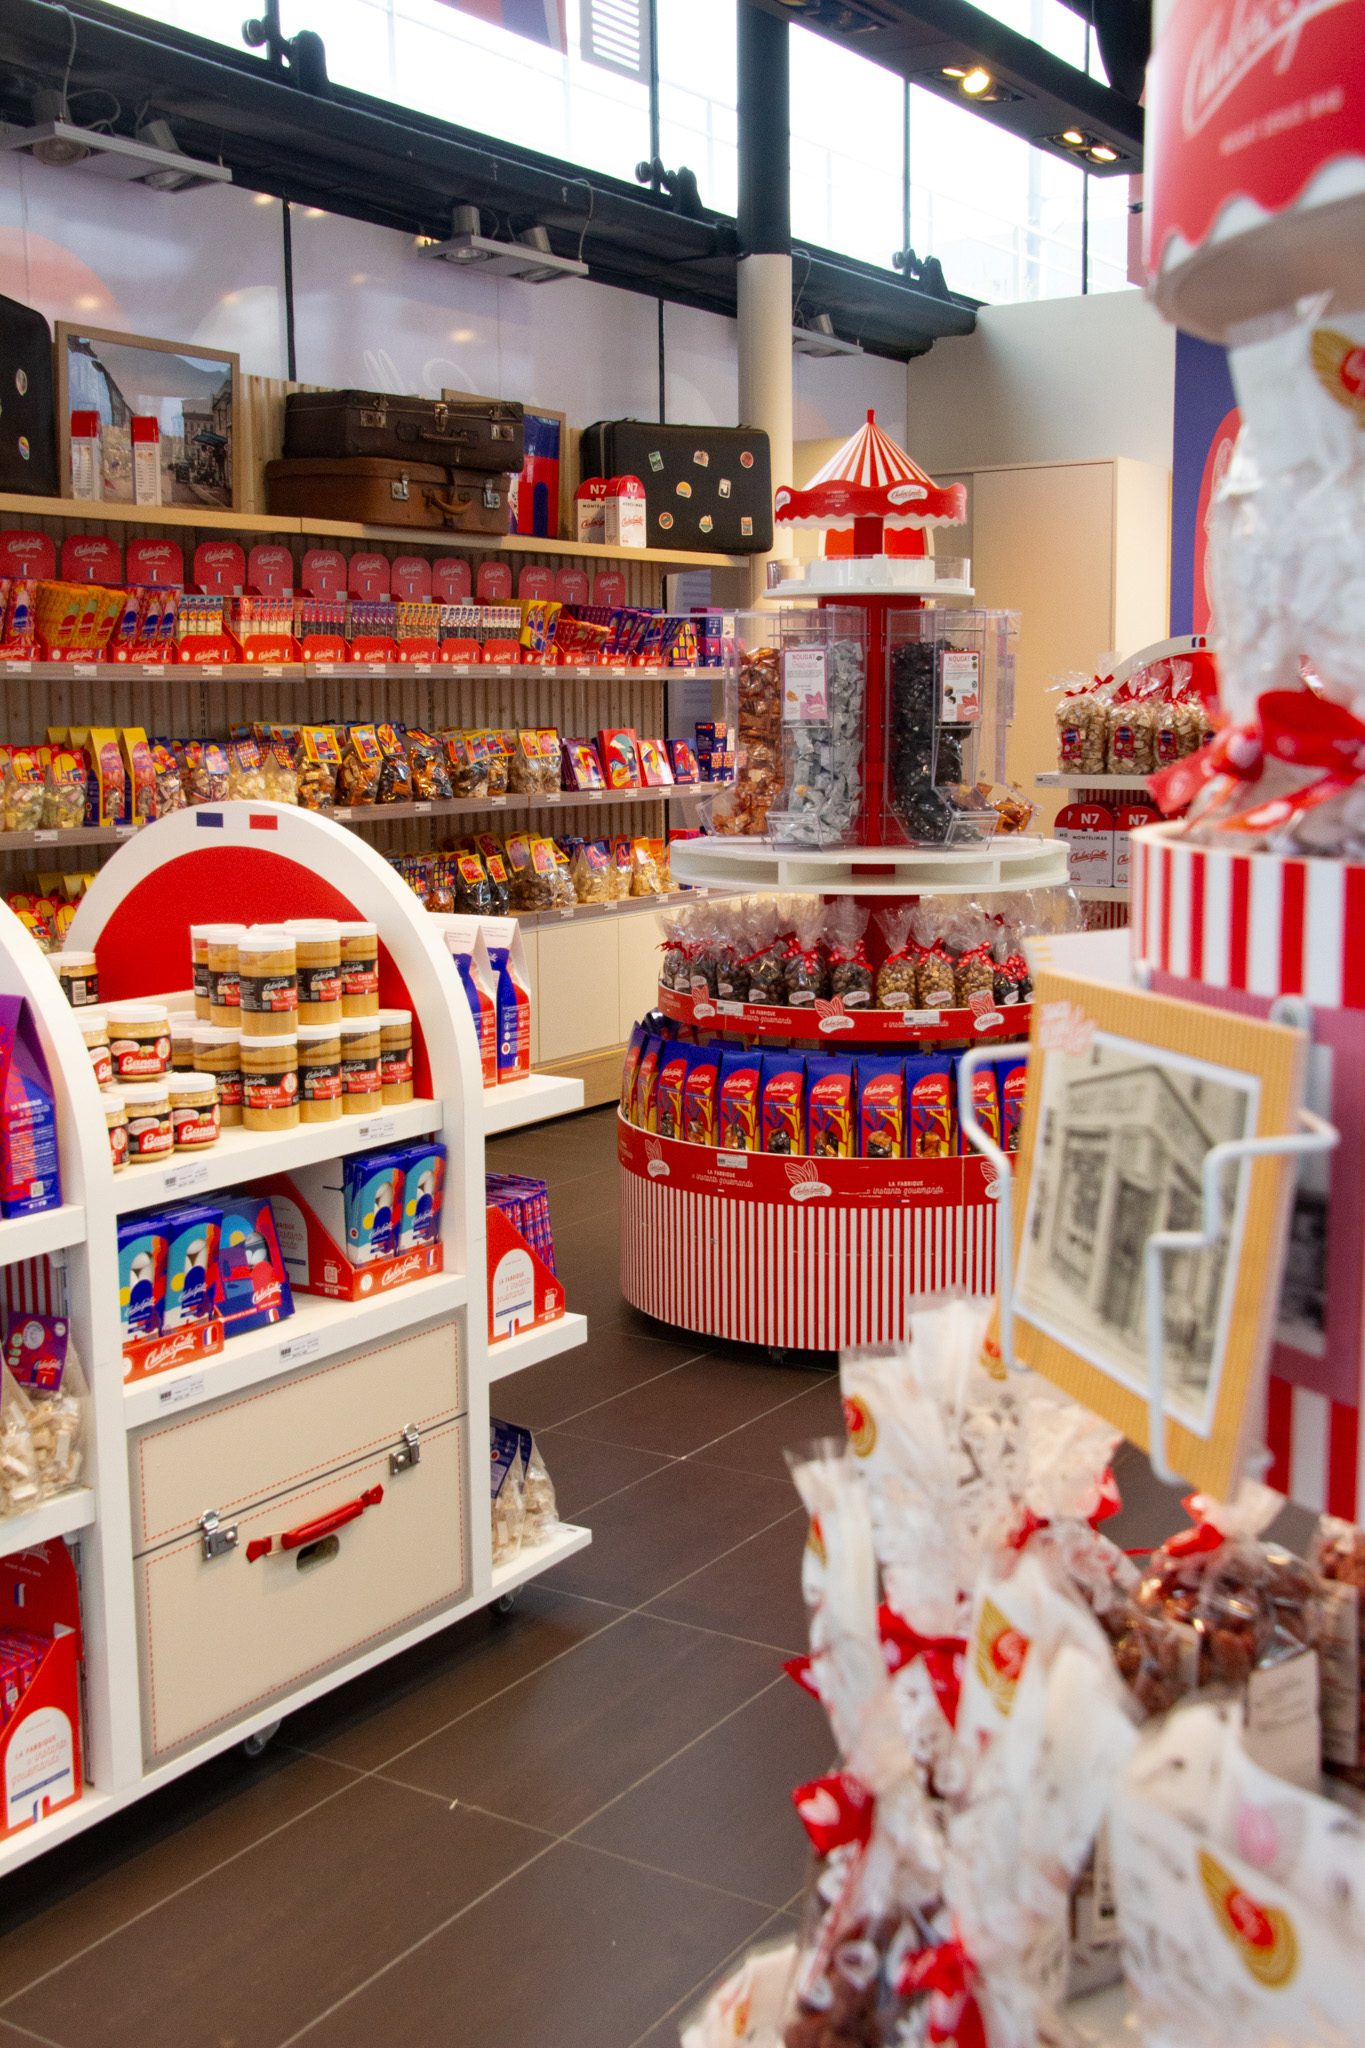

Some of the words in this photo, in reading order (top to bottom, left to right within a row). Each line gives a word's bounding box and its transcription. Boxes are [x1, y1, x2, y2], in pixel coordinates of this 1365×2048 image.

[590, 484, 607, 495] N7
[626, 482, 638, 493] N7
[792, 653, 815, 661] NOUGAT
[1081, 813, 1100, 824] N7
[1128, 814, 1148, 826] N7
[714, 1170, 736, 1178] FABRIQUE
[903, 1185, 944, 1196] gourmands
[15, 1751, 23, 1760] LA
[26, 1734, 57, 1755] FABRIQUE
